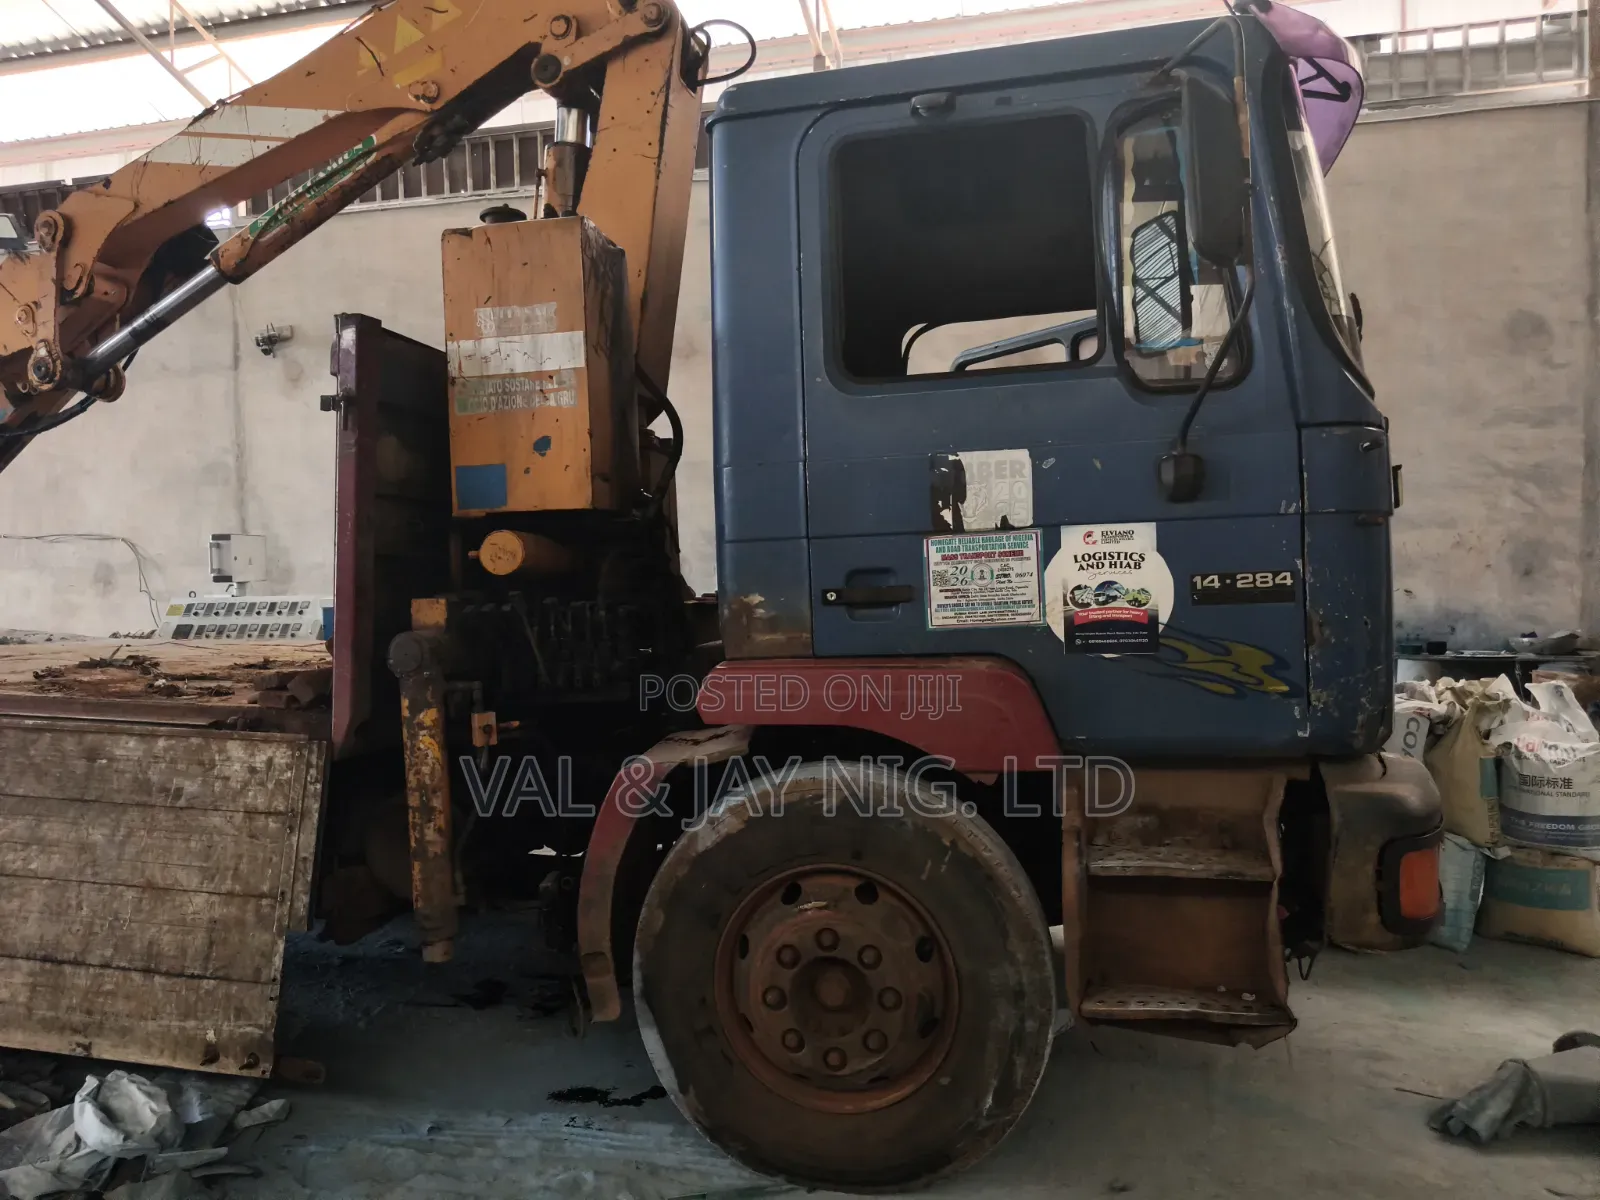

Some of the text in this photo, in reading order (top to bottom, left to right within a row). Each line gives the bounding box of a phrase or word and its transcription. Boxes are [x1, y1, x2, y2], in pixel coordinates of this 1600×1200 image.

[1073, 551, 1146, 564] LOGISTICS
[1077, 561, 1142, 571] AND HIAB
[1518, 772, 1574, 790] 国际标准
